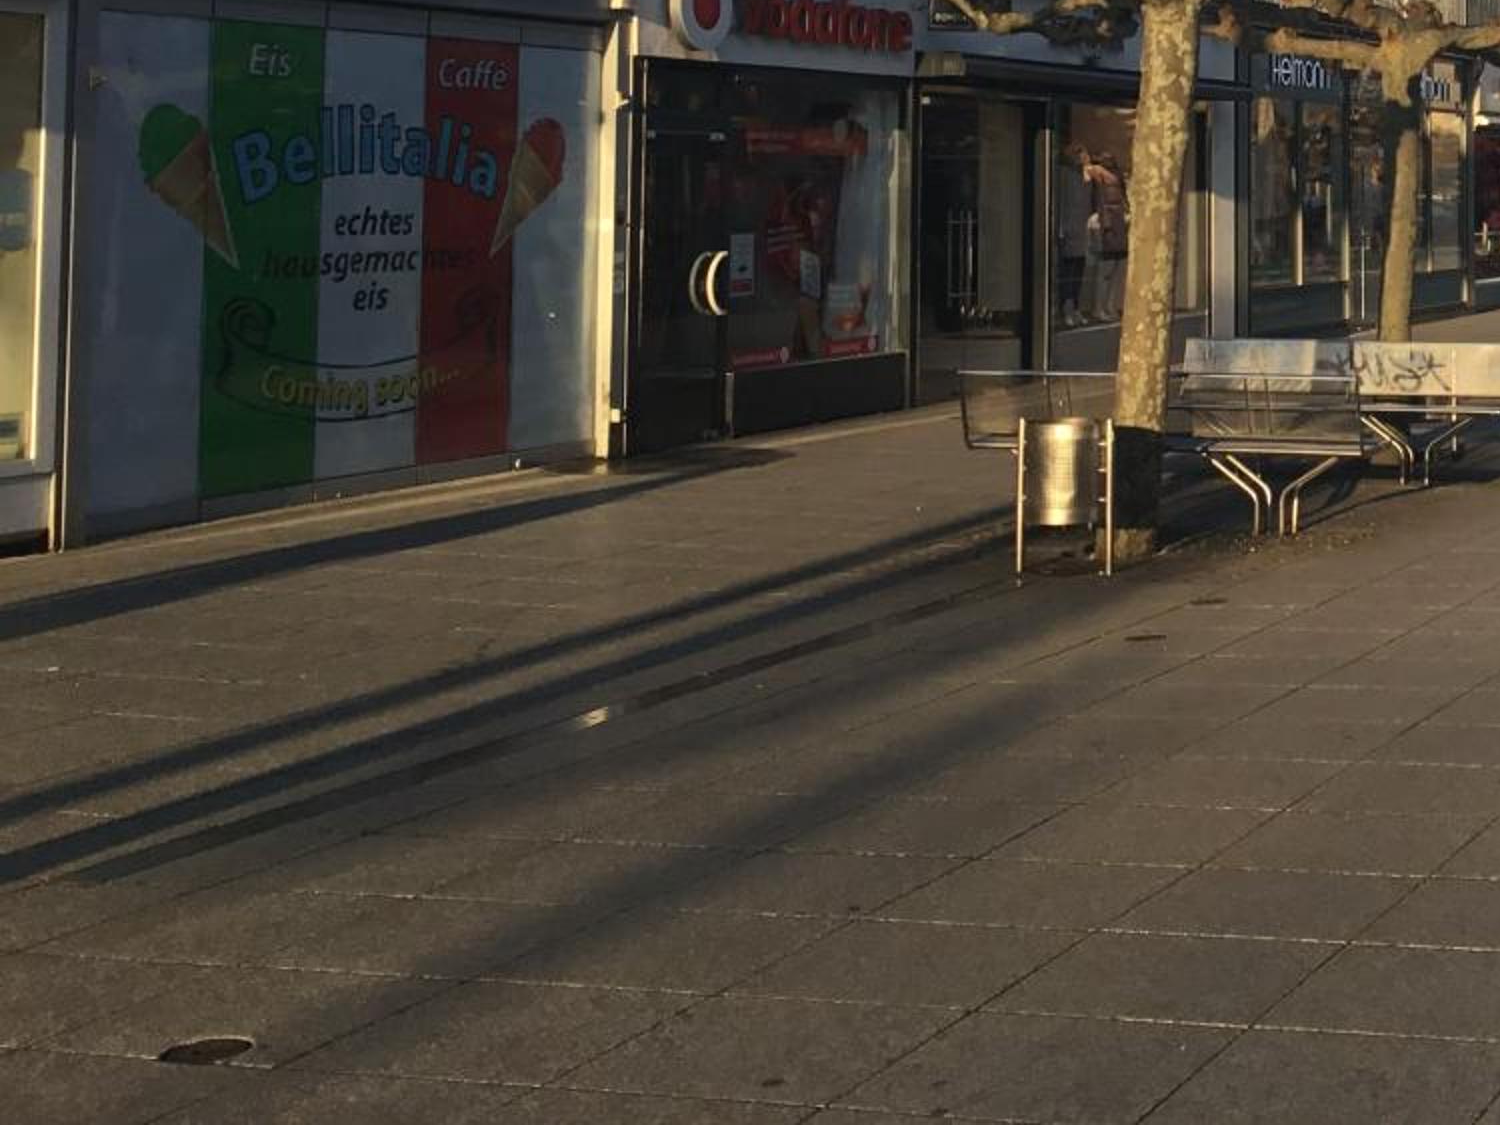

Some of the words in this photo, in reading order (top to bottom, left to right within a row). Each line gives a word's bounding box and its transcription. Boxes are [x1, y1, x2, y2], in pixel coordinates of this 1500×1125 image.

[250, 43, 291, 76] Eis
[231, 103, 499, 206] Bellitalia
[334, 206, 415, 236] echtes
[352, 281, 389, 311] eis
[260, 364, 369, 416] Coming
